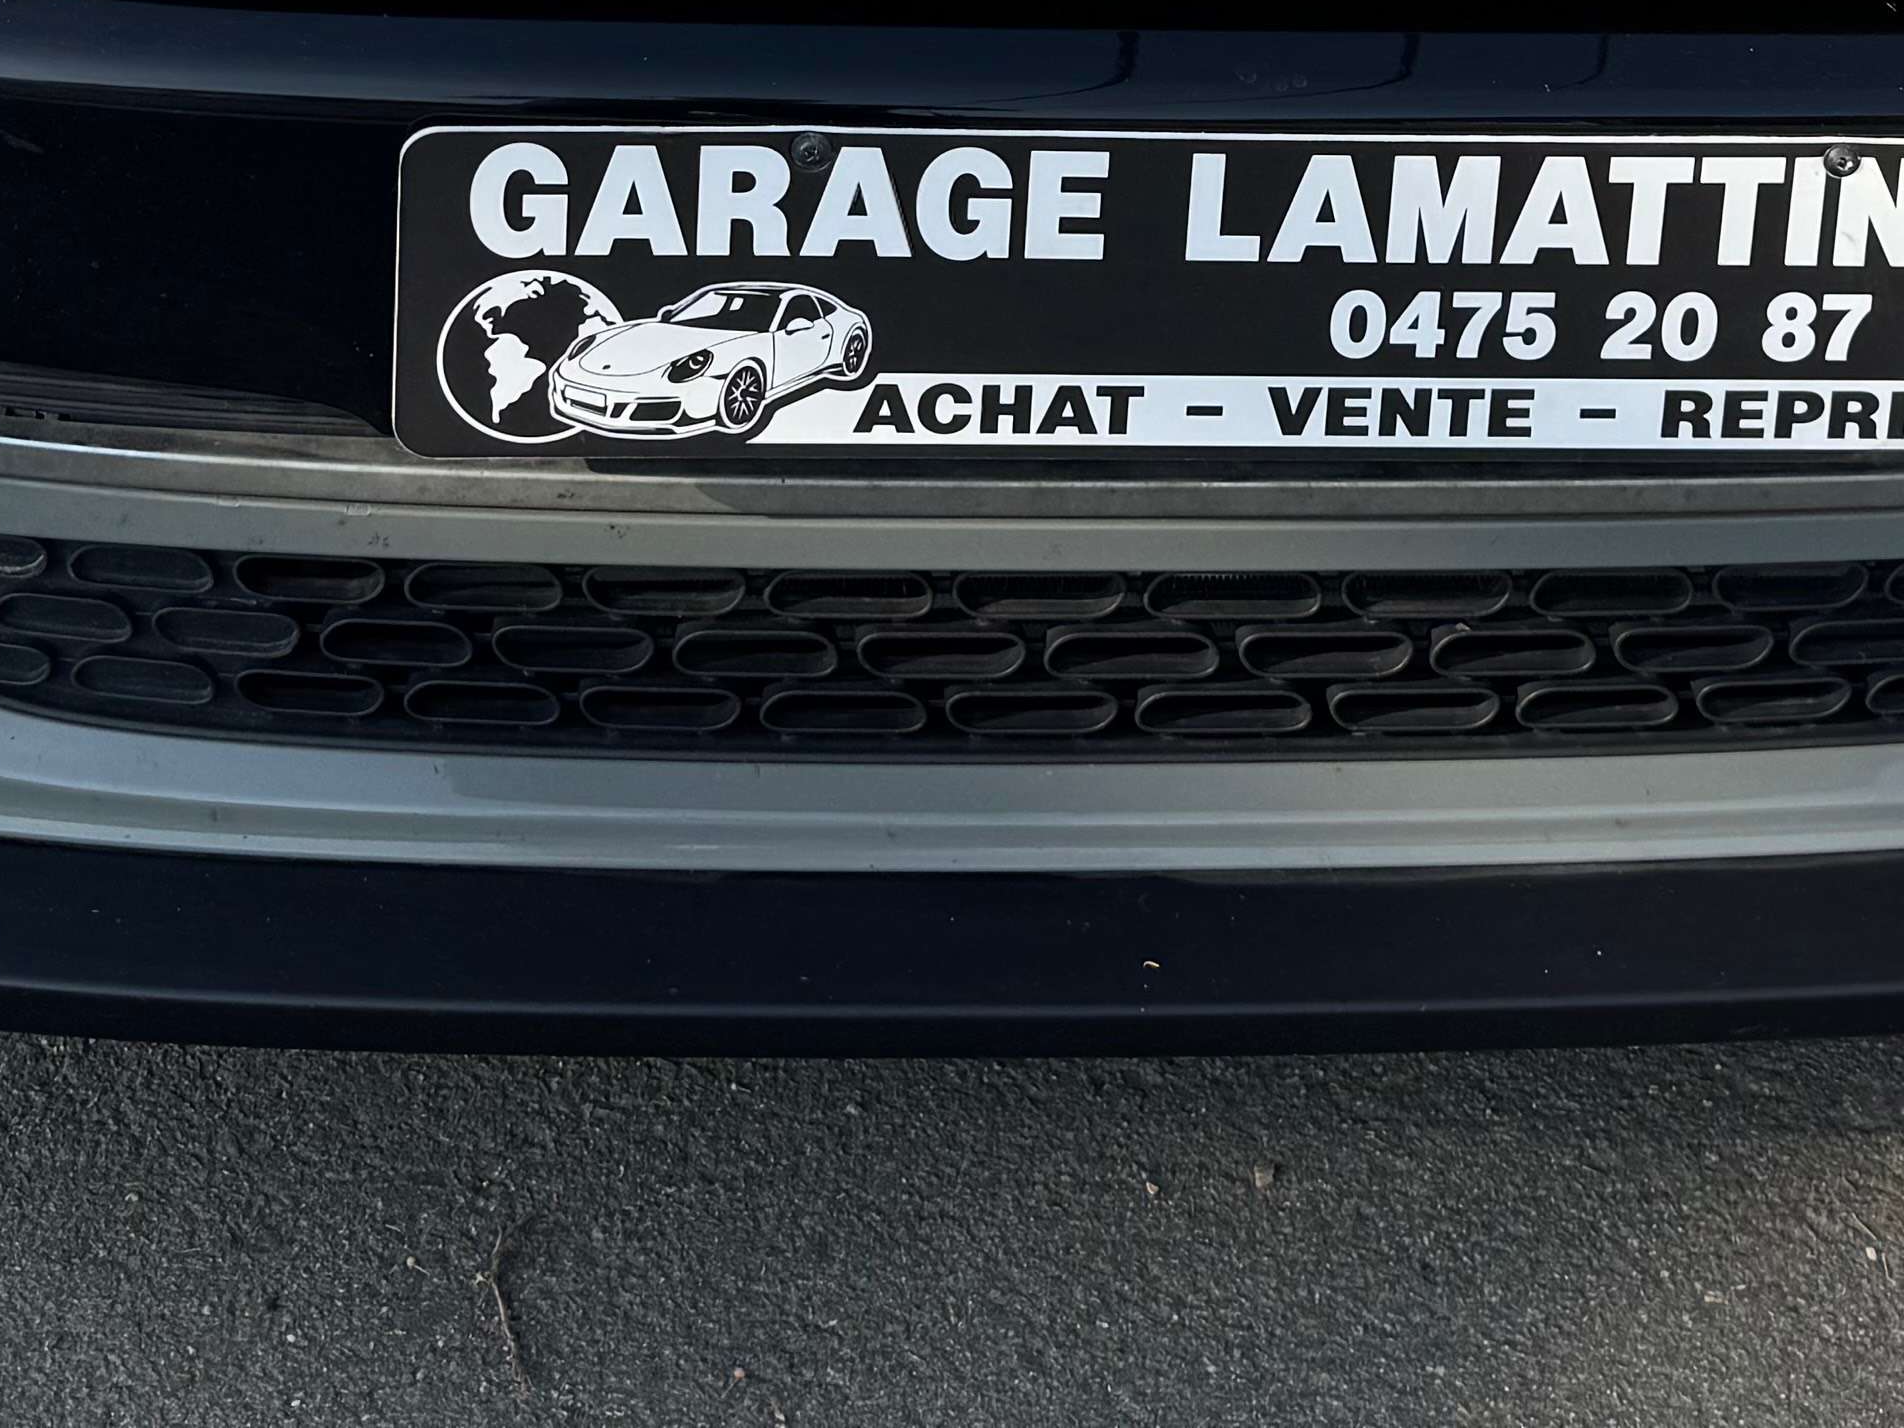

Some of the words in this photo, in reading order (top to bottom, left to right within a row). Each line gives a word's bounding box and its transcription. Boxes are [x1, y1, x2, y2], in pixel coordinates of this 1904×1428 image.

[469, 142, 1110, 260] GARAGE
[1329, 290, 1557, 361] 0475
[1600, 290, 1718, 362] 20
[1761, 291, 1873, 363] 87
[853, 382, 1145, 435] ACHAT
[1268, 386, 1535, 438] VENTE
